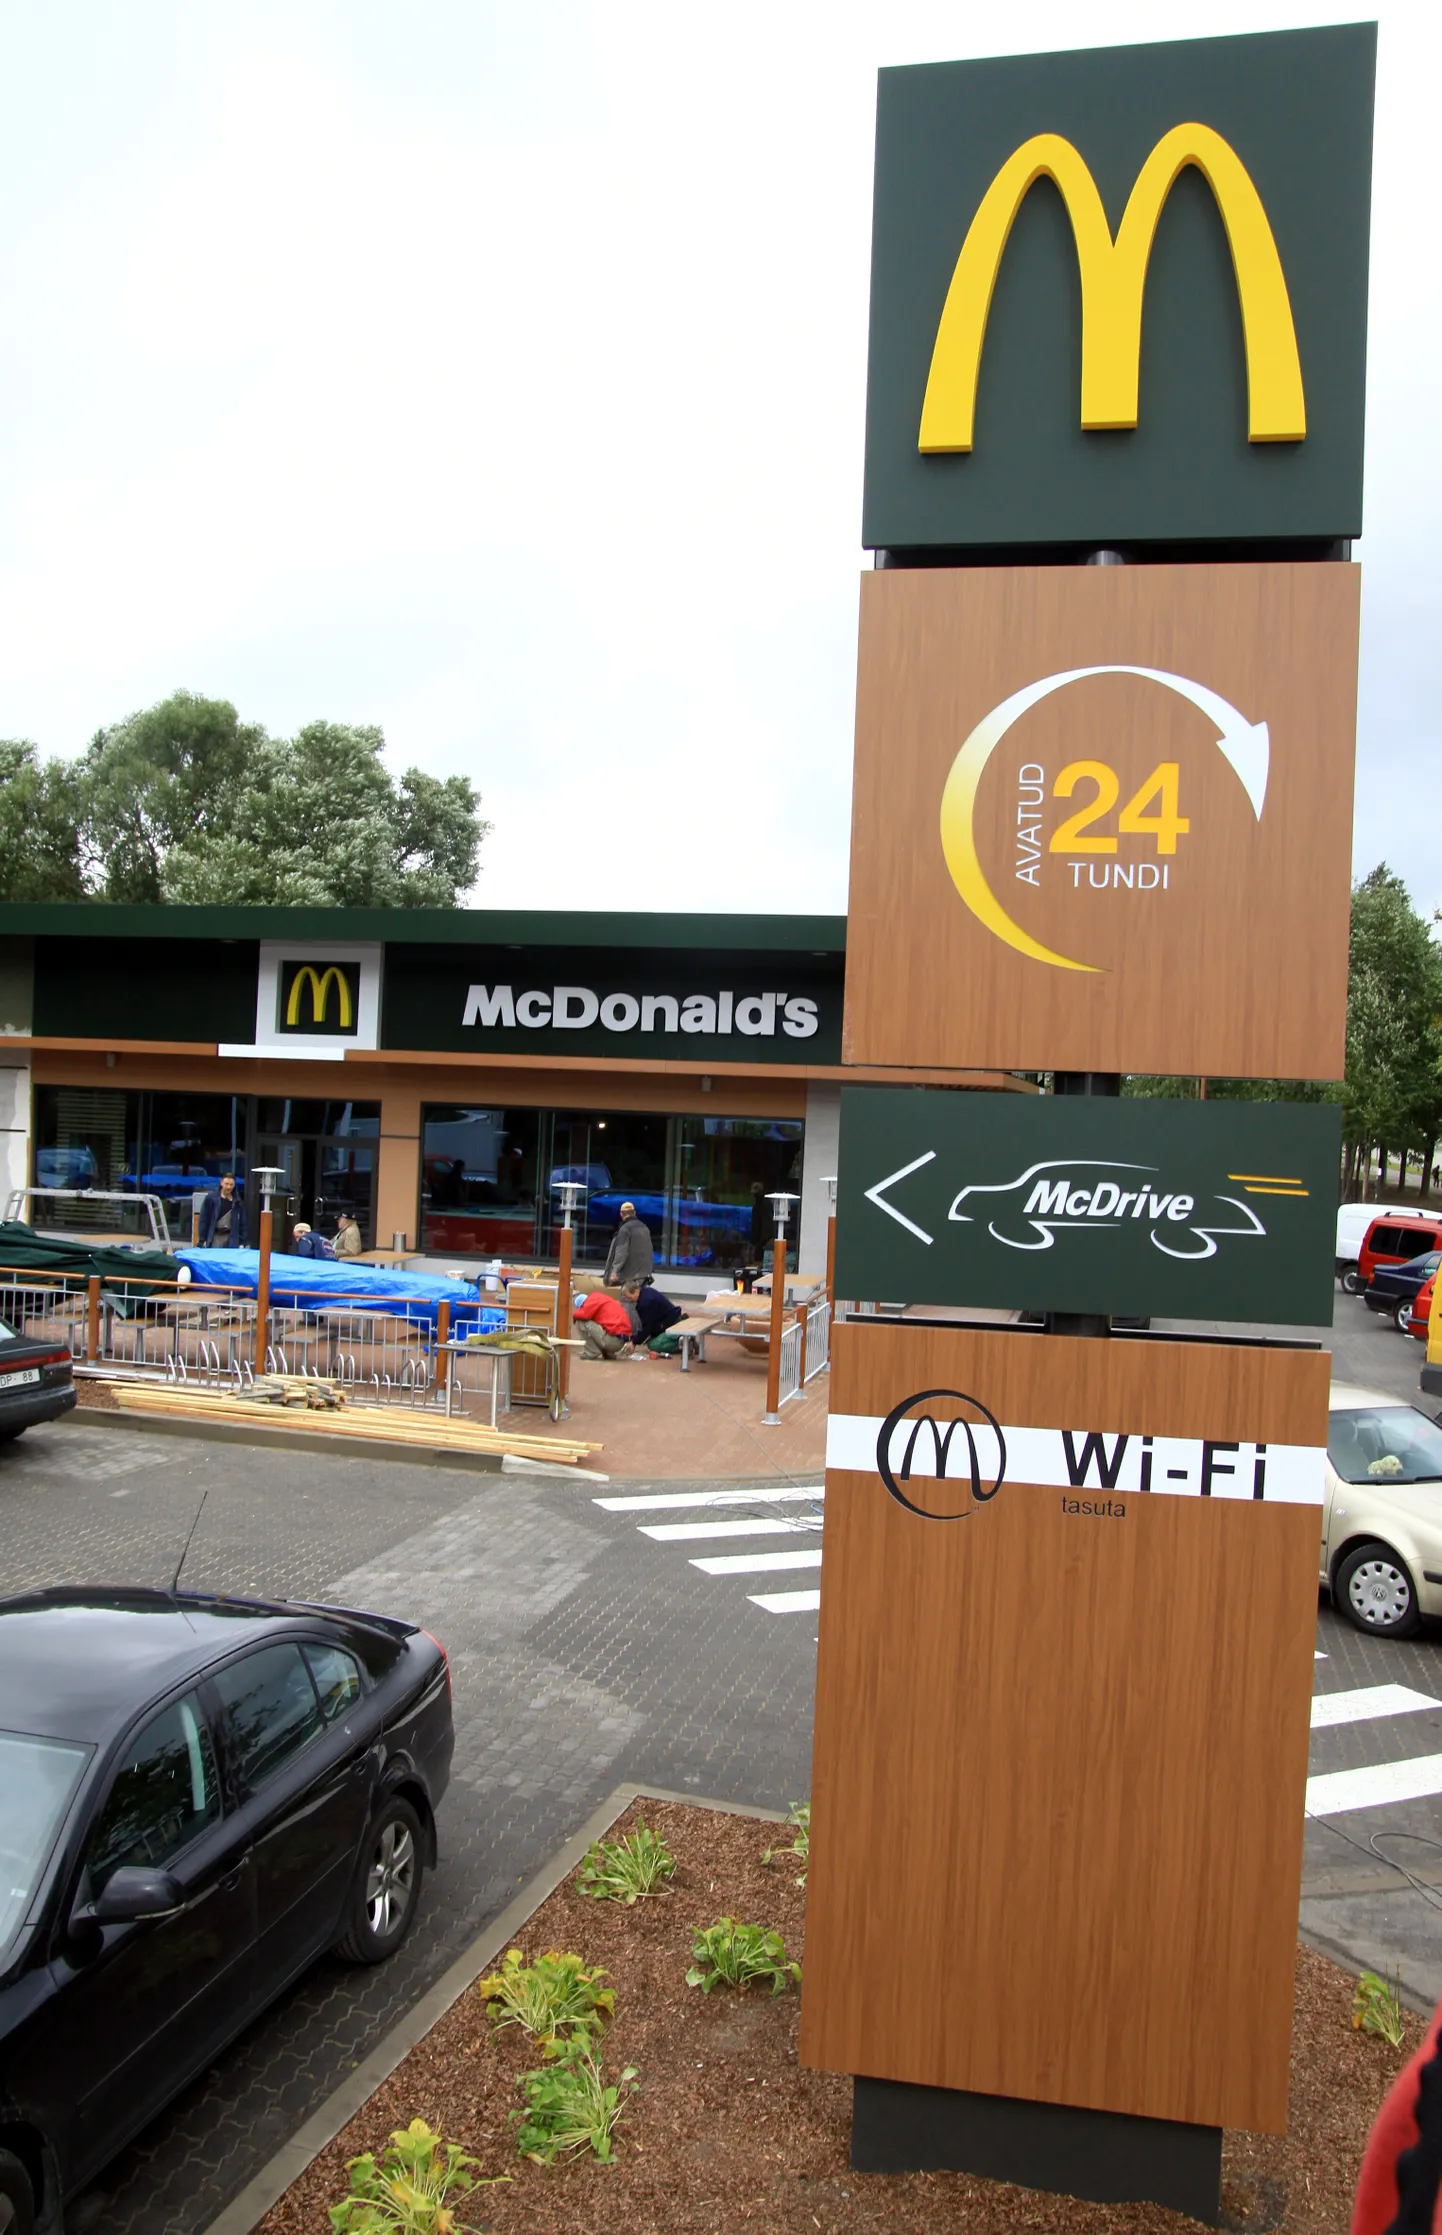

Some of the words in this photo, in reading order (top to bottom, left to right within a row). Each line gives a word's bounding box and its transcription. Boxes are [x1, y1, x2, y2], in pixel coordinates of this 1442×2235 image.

[1015, 763, 1045, 887] AVATUD
[1048, 759, 1190, 855] 24
[1067, 862, 1169, 889] TUNDI
[462, 984, 819, 1038] McDonald's
[1022, 1179, 1195, 1221] McDrive
[1061, 1430, 1267, 1500] Wi-Fi
[1062, 1496, 1126, 1518] tasuta
